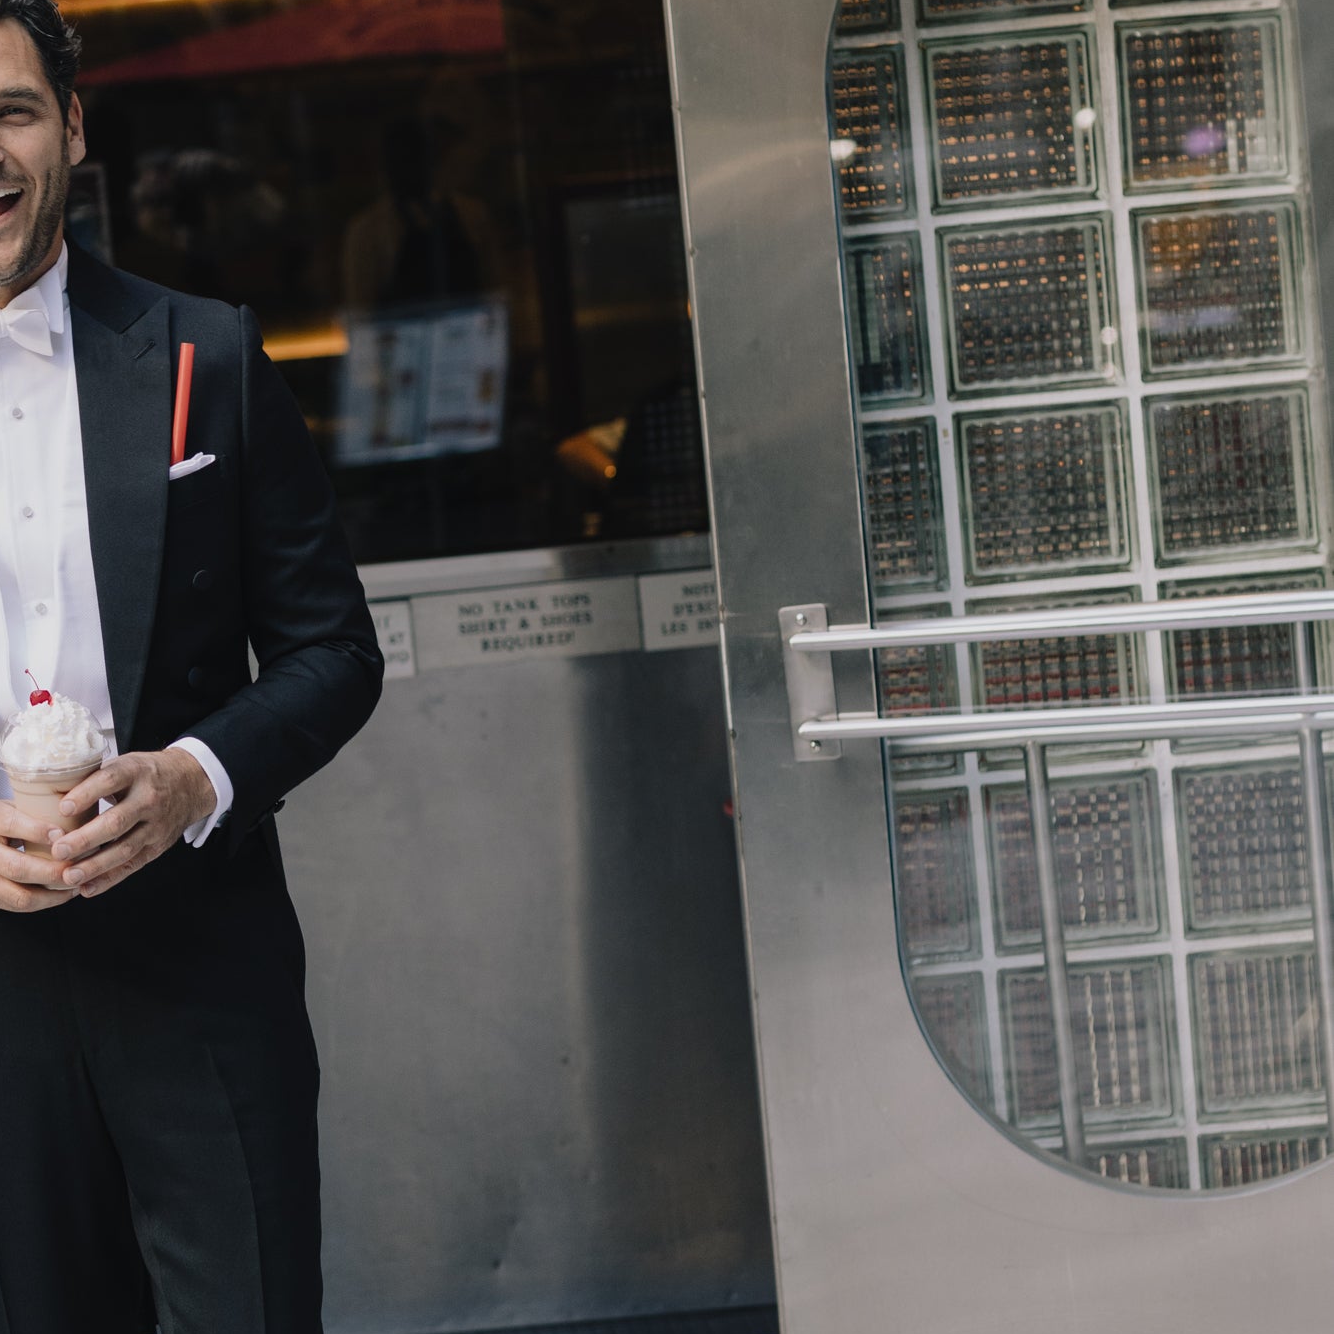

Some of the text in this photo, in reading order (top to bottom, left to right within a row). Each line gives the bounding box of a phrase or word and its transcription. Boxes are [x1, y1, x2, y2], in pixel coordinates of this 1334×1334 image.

[459, 593, 592, 616] NO TANK TOPS
[459, 610, 594, 634] SHIRT & SHOES
